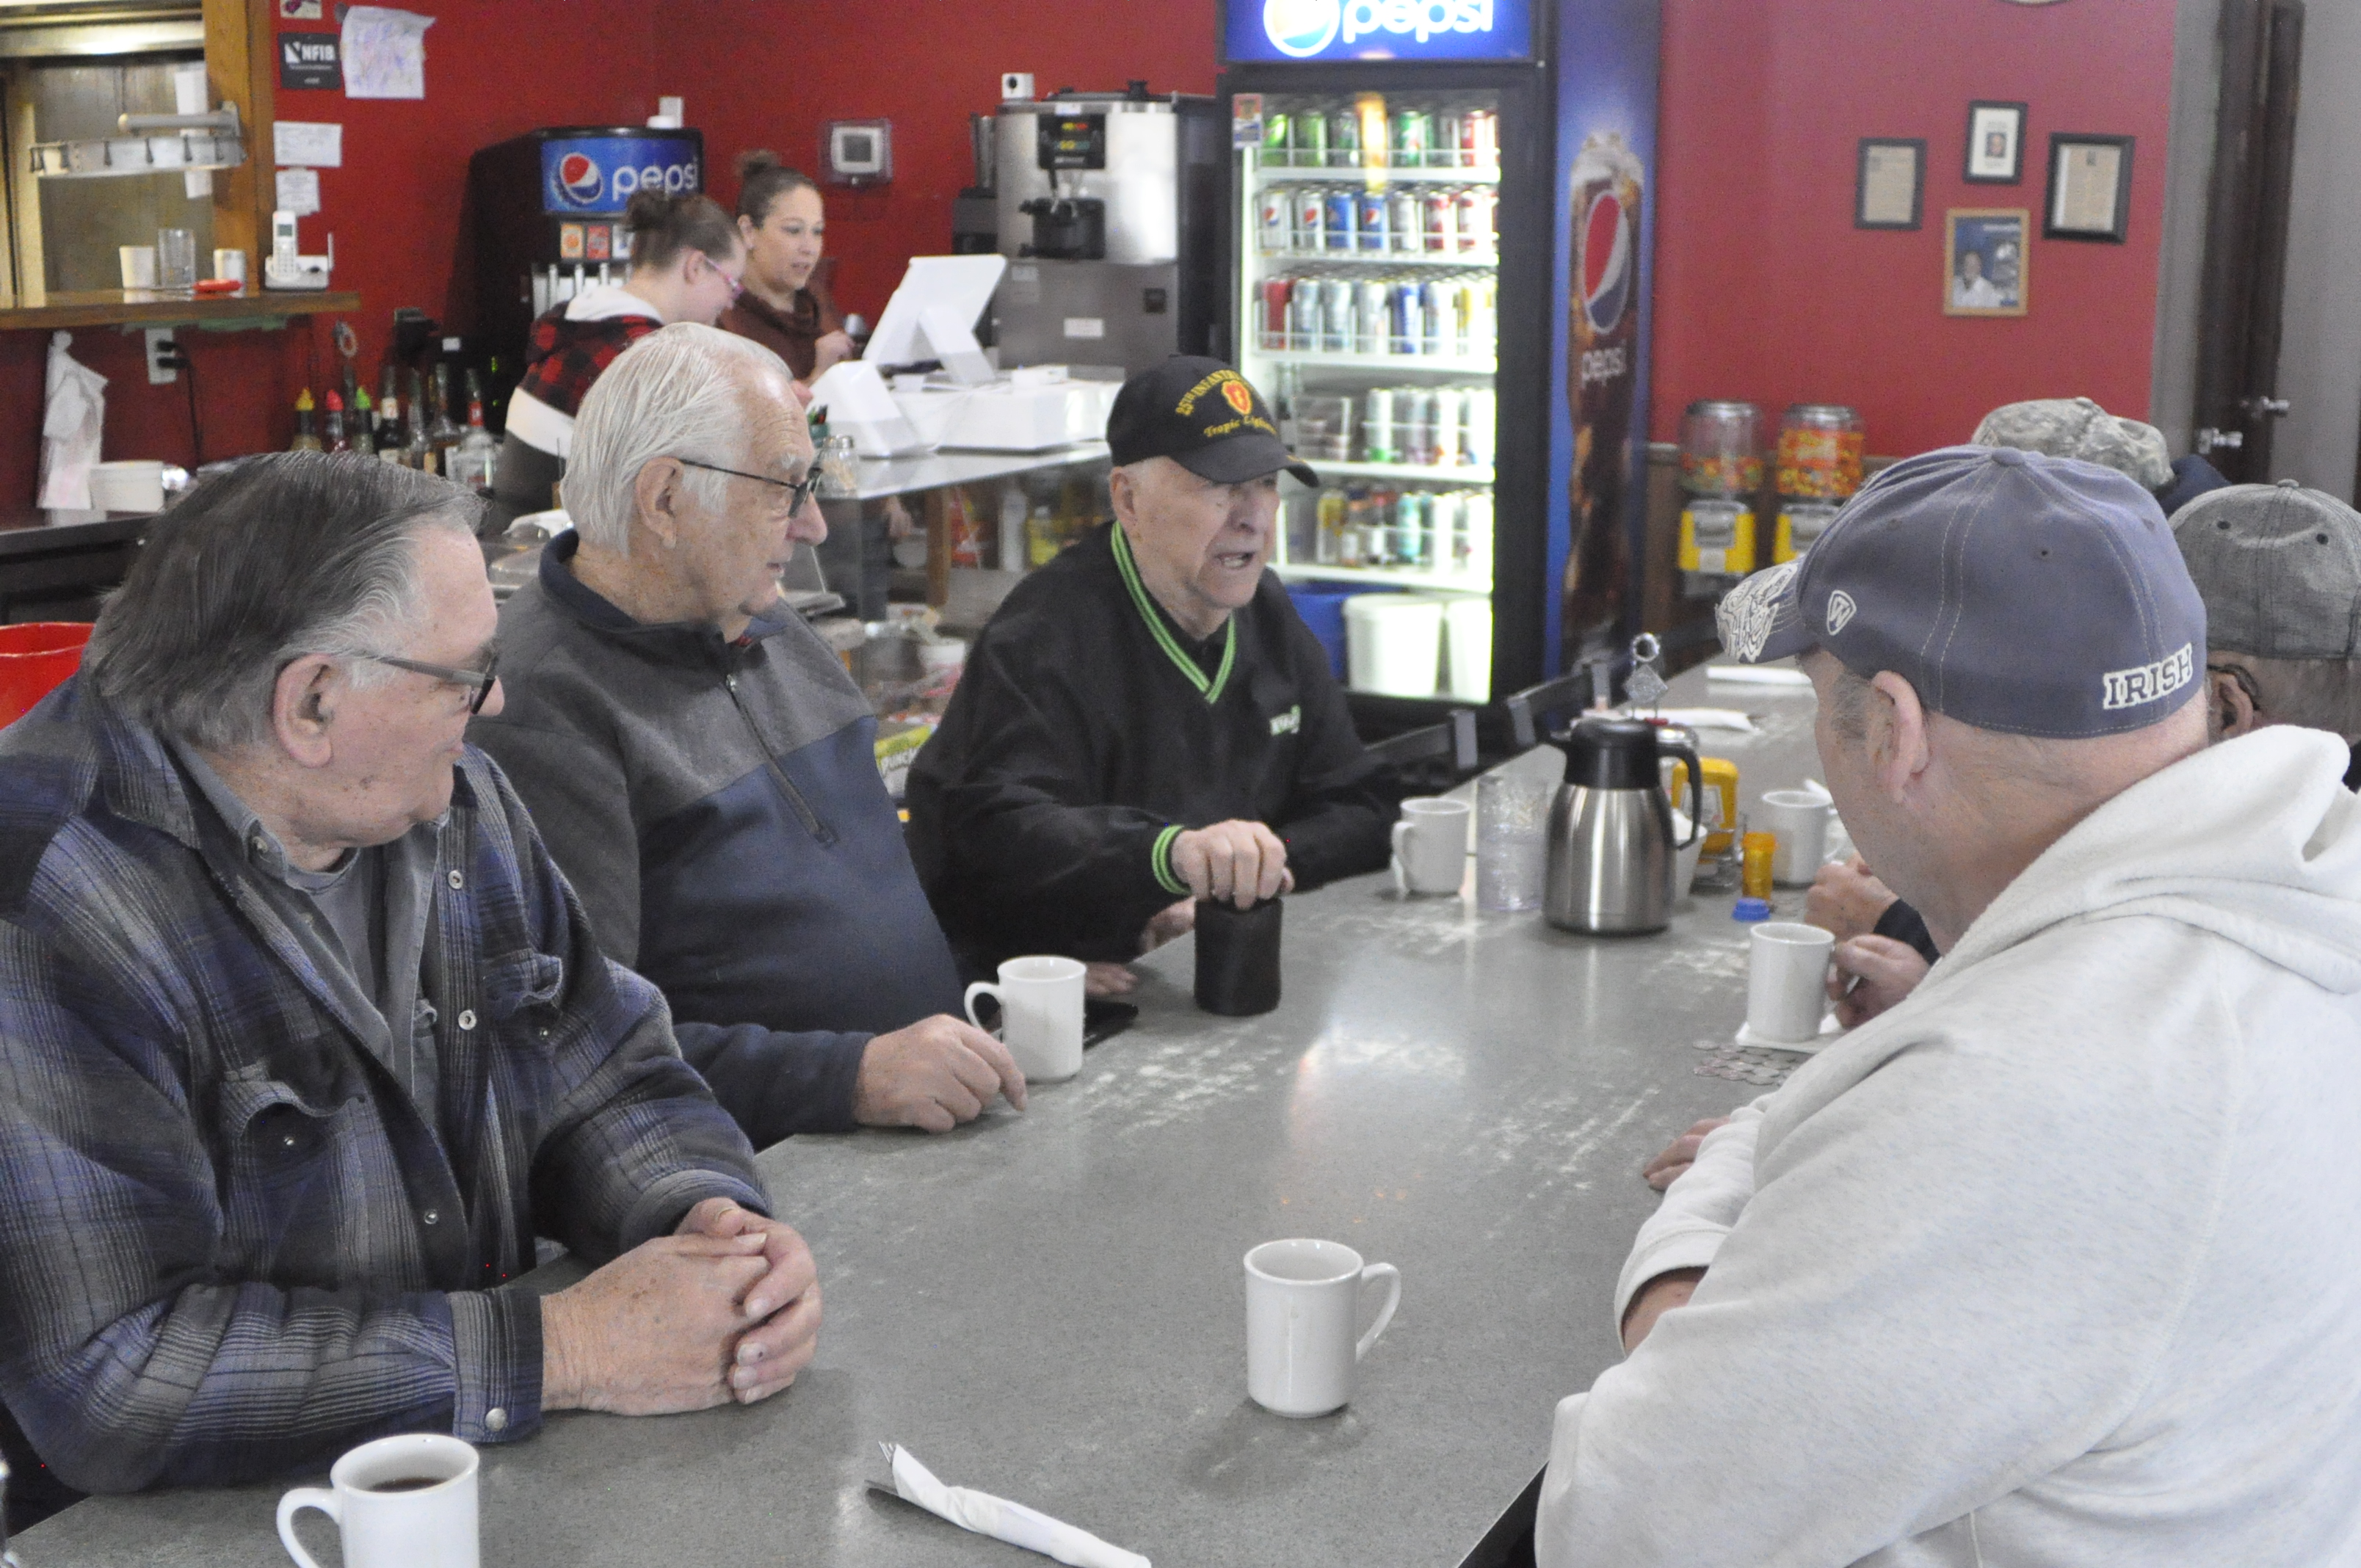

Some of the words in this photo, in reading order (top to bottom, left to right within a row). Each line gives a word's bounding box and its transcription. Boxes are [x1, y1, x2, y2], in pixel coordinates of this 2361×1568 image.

[1343, 0, 1493, 43] pepsi
[301, 43, 336, 62] NFIB
[1581, 339, 1627, 390] pepsi
[1204, 418, 1240, 437] Tropic
[2103, 643, 2193, 708] IRISH
